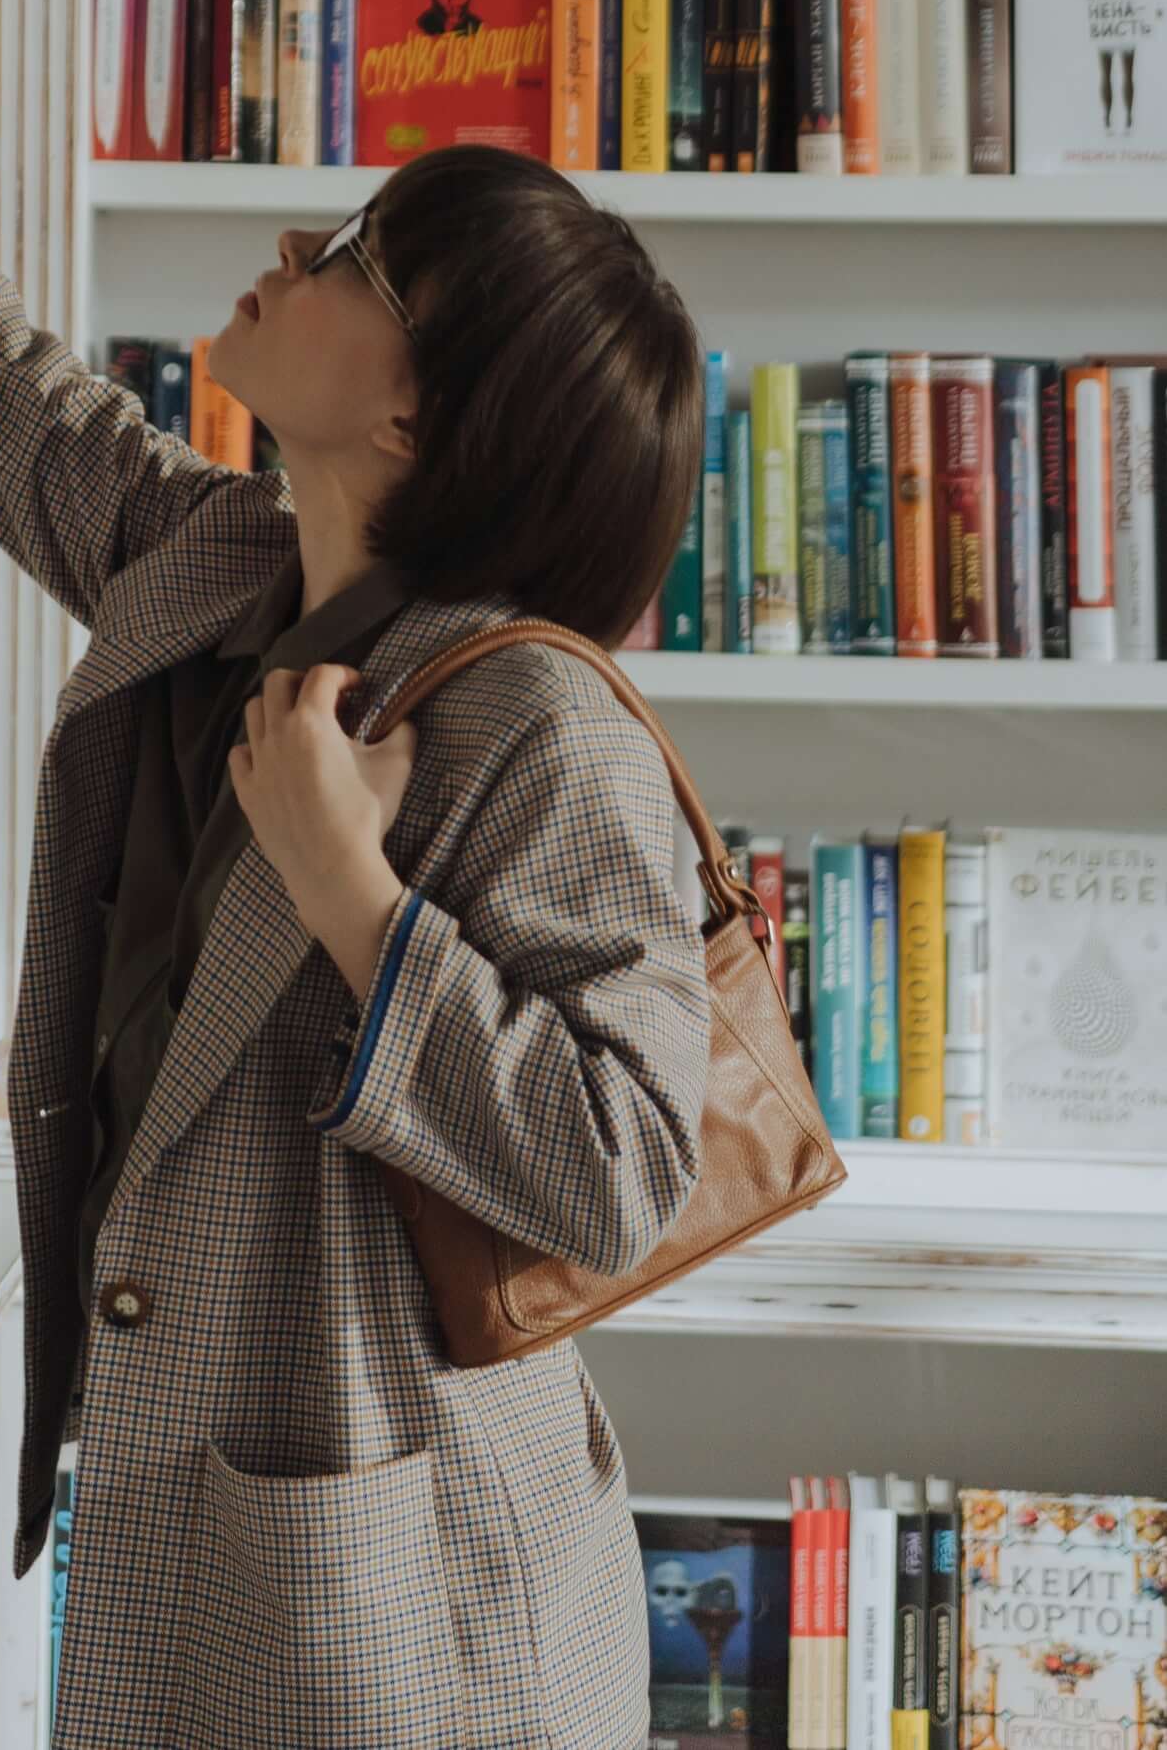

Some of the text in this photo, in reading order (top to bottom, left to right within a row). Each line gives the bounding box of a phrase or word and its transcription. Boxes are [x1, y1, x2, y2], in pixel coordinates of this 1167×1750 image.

[1089, 20, 1152, 39] ВИСТЬ
[1034, 848, 1156, 873] МИШЕЛЬ
[1010, 872, 1167, 903] ФЕЙБЕ
[1011, 1564, 1126, 1602] КЕЙТ
[979, 1601, 1154, 1640] МОРТОН
